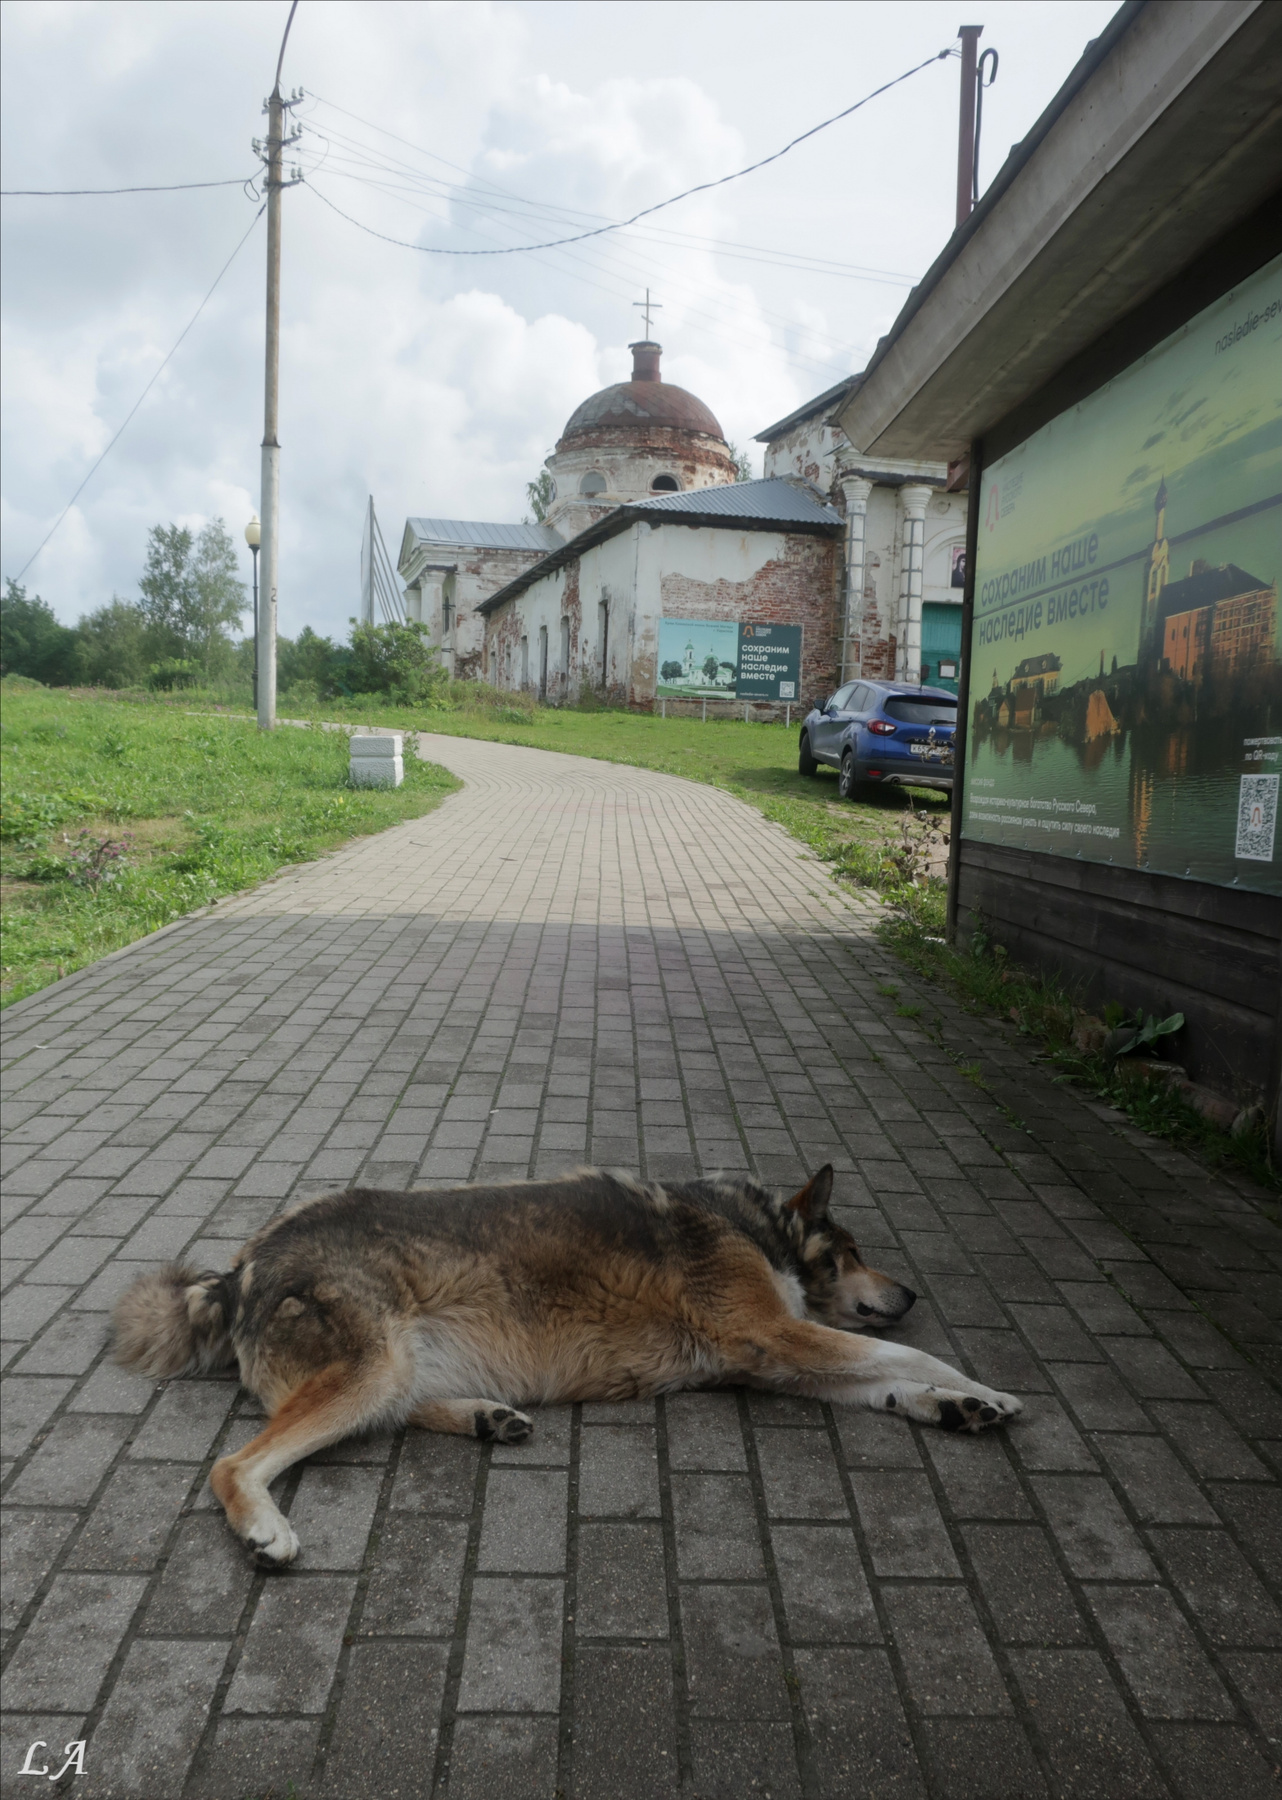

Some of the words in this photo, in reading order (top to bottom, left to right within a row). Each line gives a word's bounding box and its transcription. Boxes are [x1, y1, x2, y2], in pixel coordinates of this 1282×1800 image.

[981, 556, 1047, 607] сохраним
[1051, 533, 1099, 579] наше
[979, 601, 1043, 646] наследие
[1047, 577, 1110, 626] вместе
[741, 644, 790, 655] сохраним
[741, 654, 769, 662] наше
[741, 663, 789, 673] наследие
[740, 672, 776, 680] вместе
[1053, 798, 1075, 814] Русского
